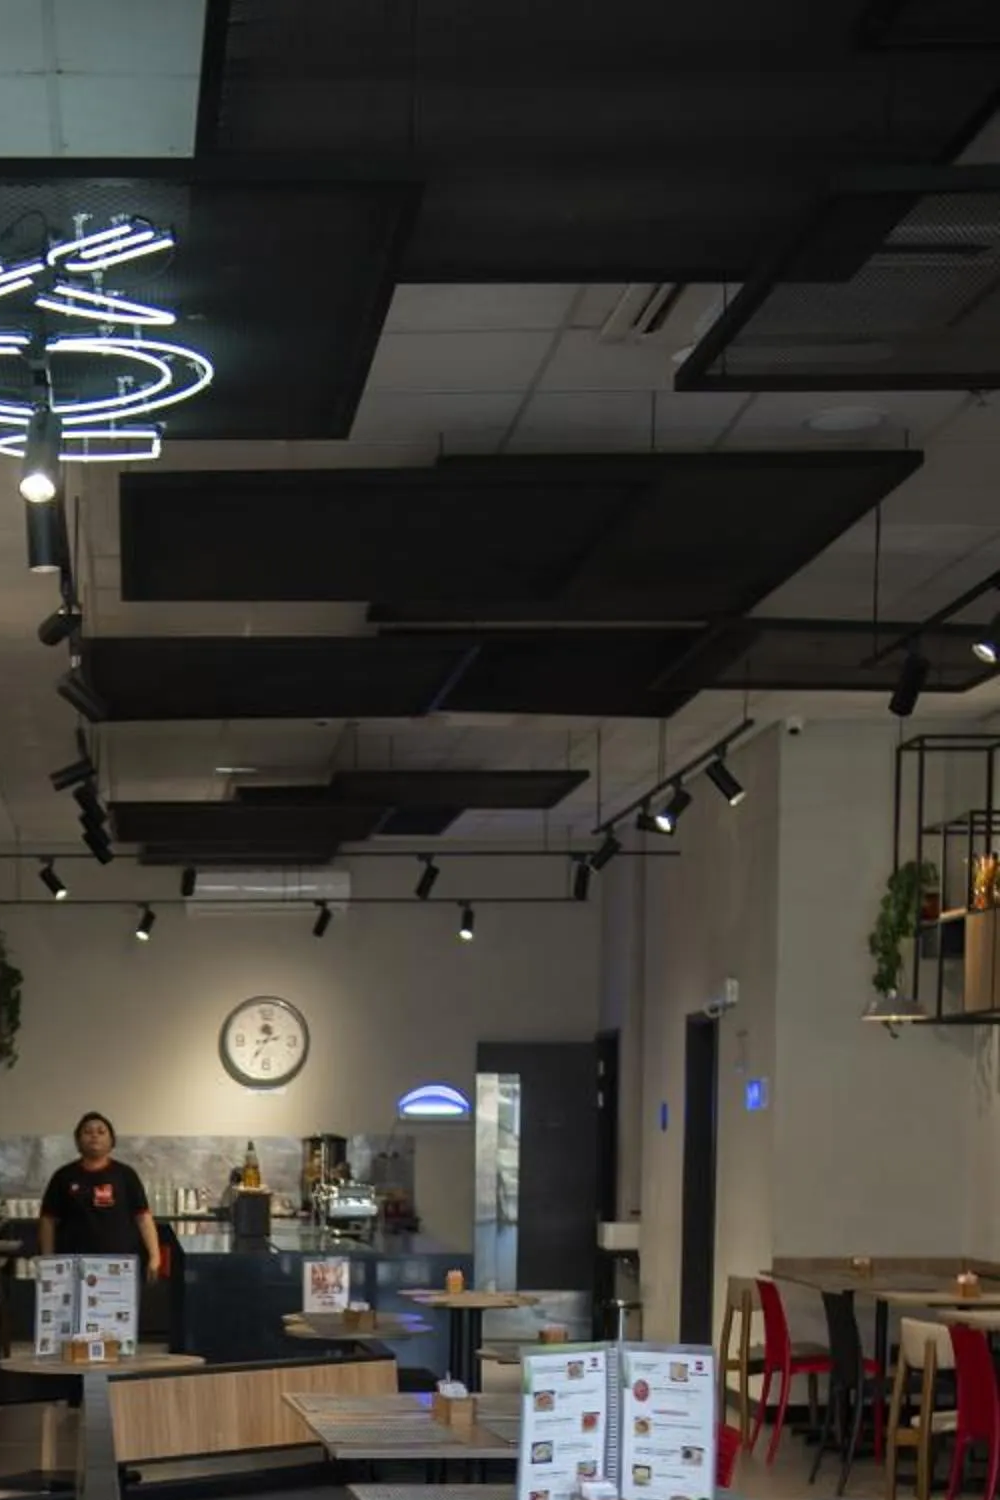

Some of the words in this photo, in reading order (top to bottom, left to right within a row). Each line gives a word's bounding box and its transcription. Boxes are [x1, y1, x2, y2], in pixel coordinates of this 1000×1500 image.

[235, 1033, 246, 1048] 9
[286, 1034, 298, 1048] 3
[260, 1058, 271, 1071] 6
